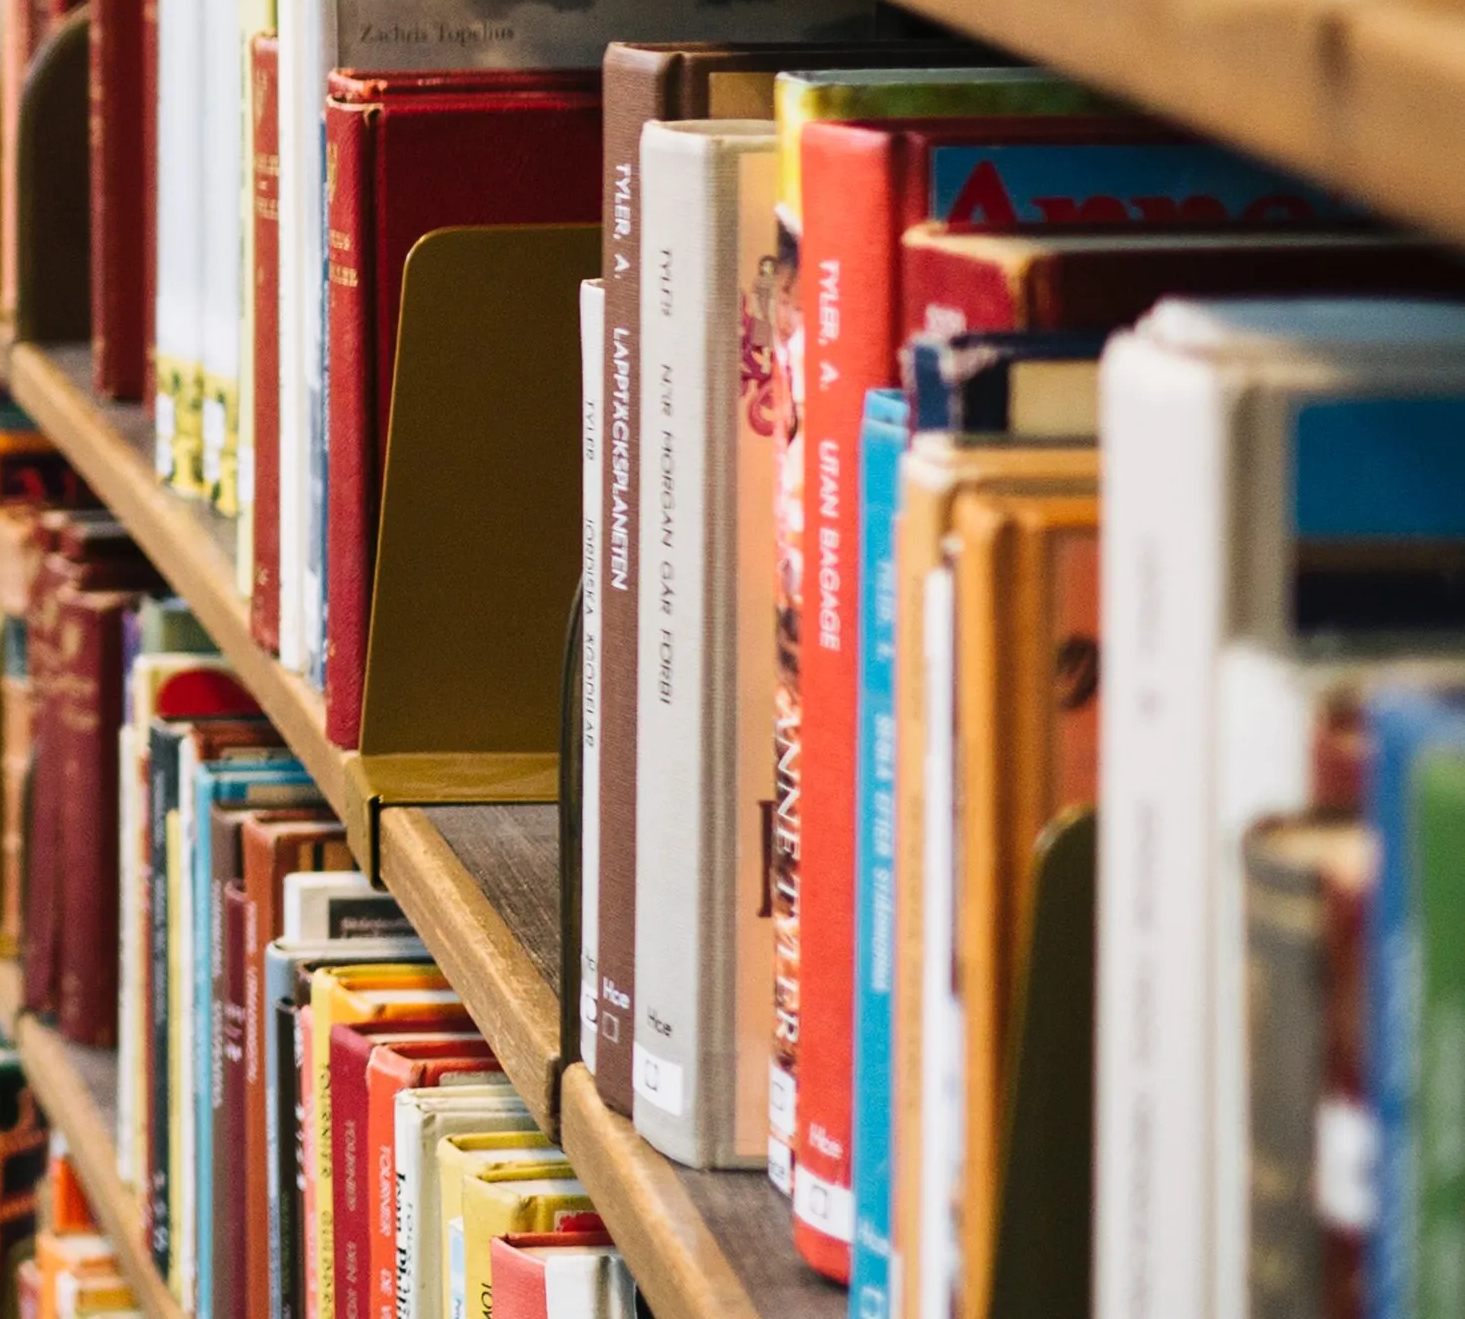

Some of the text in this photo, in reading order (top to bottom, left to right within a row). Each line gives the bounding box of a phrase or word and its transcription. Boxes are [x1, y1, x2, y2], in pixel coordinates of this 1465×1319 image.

[612, 163, 632, 240] TYLER,
[817, 259, 841, 346] TYLER,
[818, 439, 840, 518] UTAN
[818, 527, 842, 653] BAGAGE
[775, 692, 802, 1044] ANNE TYLER
[379, 1144, 392, 1237] TOURNIER
